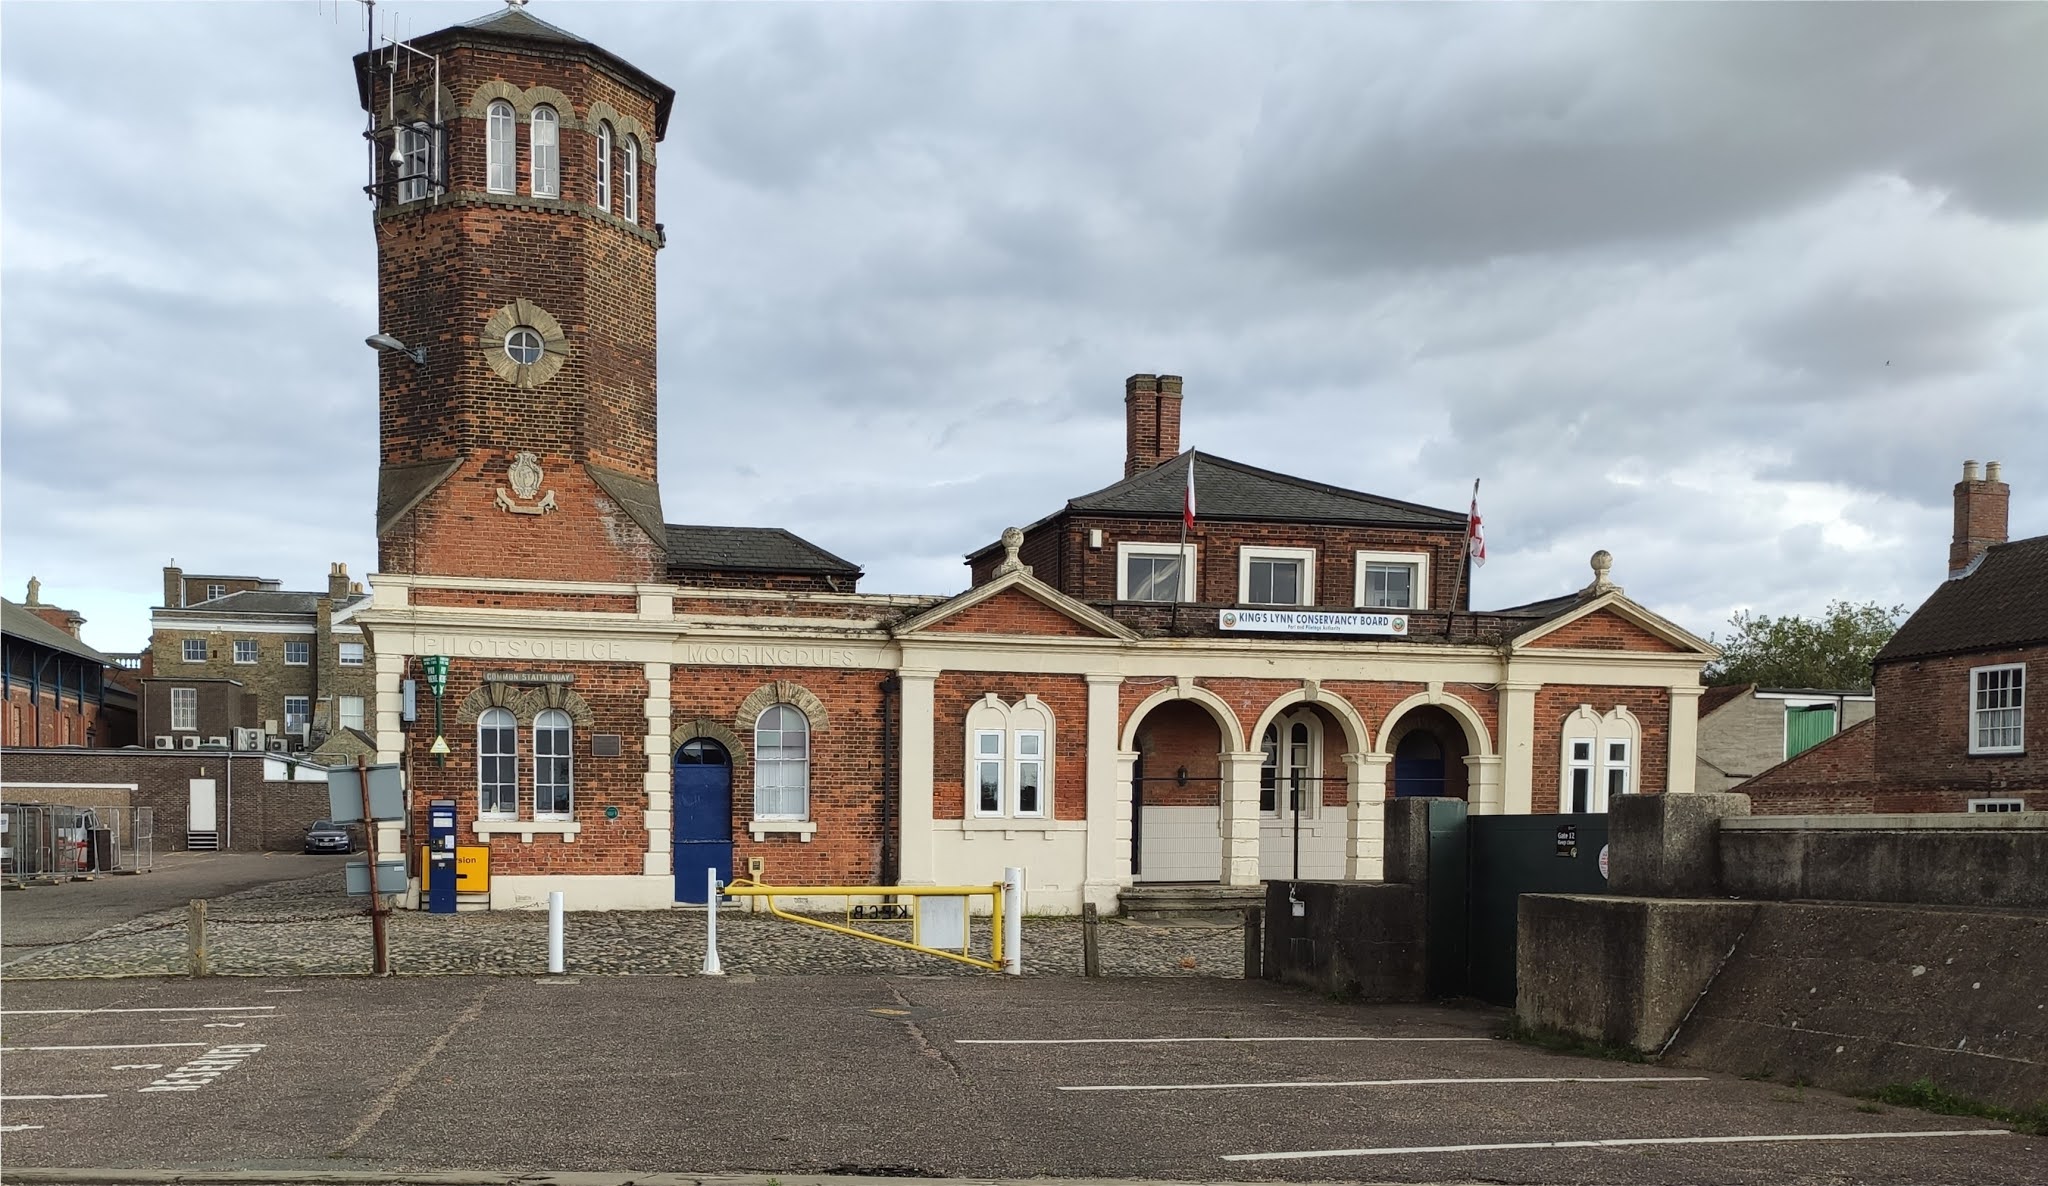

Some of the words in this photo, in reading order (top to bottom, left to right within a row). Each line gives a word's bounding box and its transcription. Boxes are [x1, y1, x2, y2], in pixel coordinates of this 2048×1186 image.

[1239, 612, 1267, 623] KING'S
[1270, 613, 1293, 624] LYNN
[1296, 614, 1358, 625] CONSERVANCY
[1360, 616, 1389, 626] BOARD
[486, 672, 519, 681] COMMON
[522, 673, 548, 682] STAITH
[551, 673, 570, 682] QUAY
[137, 1043, 267, 1092] RESERVED
